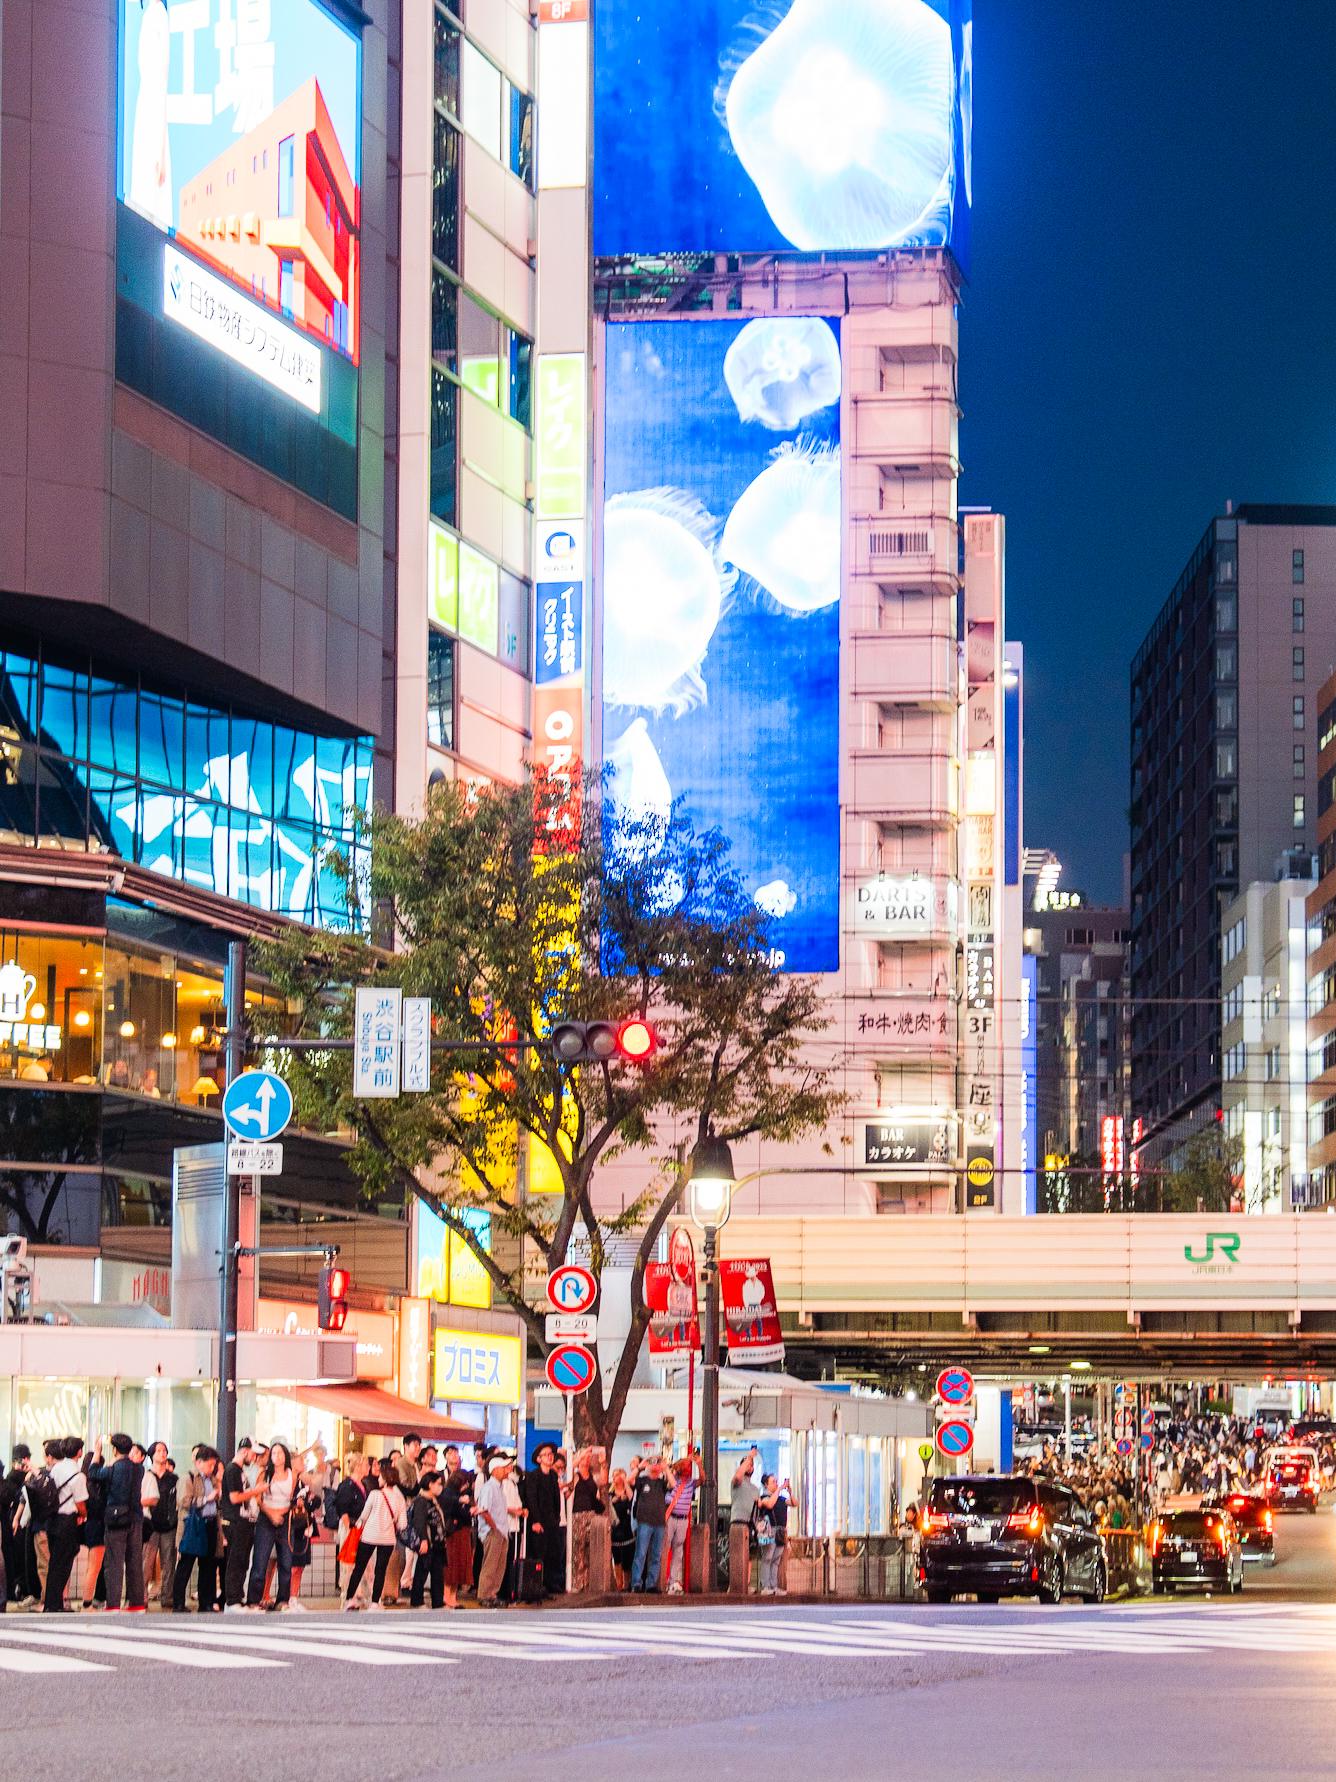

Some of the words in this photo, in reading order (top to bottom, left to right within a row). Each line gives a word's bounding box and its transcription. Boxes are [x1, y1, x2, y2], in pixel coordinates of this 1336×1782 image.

[858, 887, 927, 903] DARTS
[865, 909, 875, 920] &
[885, 905, 926, 920] BAR
[969, 1016, 992, 1033] 3F
[375, 998, 393, 1088] 渋谷駅前
[880, 1127, 904, 1142] BAR
[868, 1145, 917, 1162] カラオケ
[1184, 1232, 1241, 1263] JR
[444, 1341, 500, 1386] プロミス
